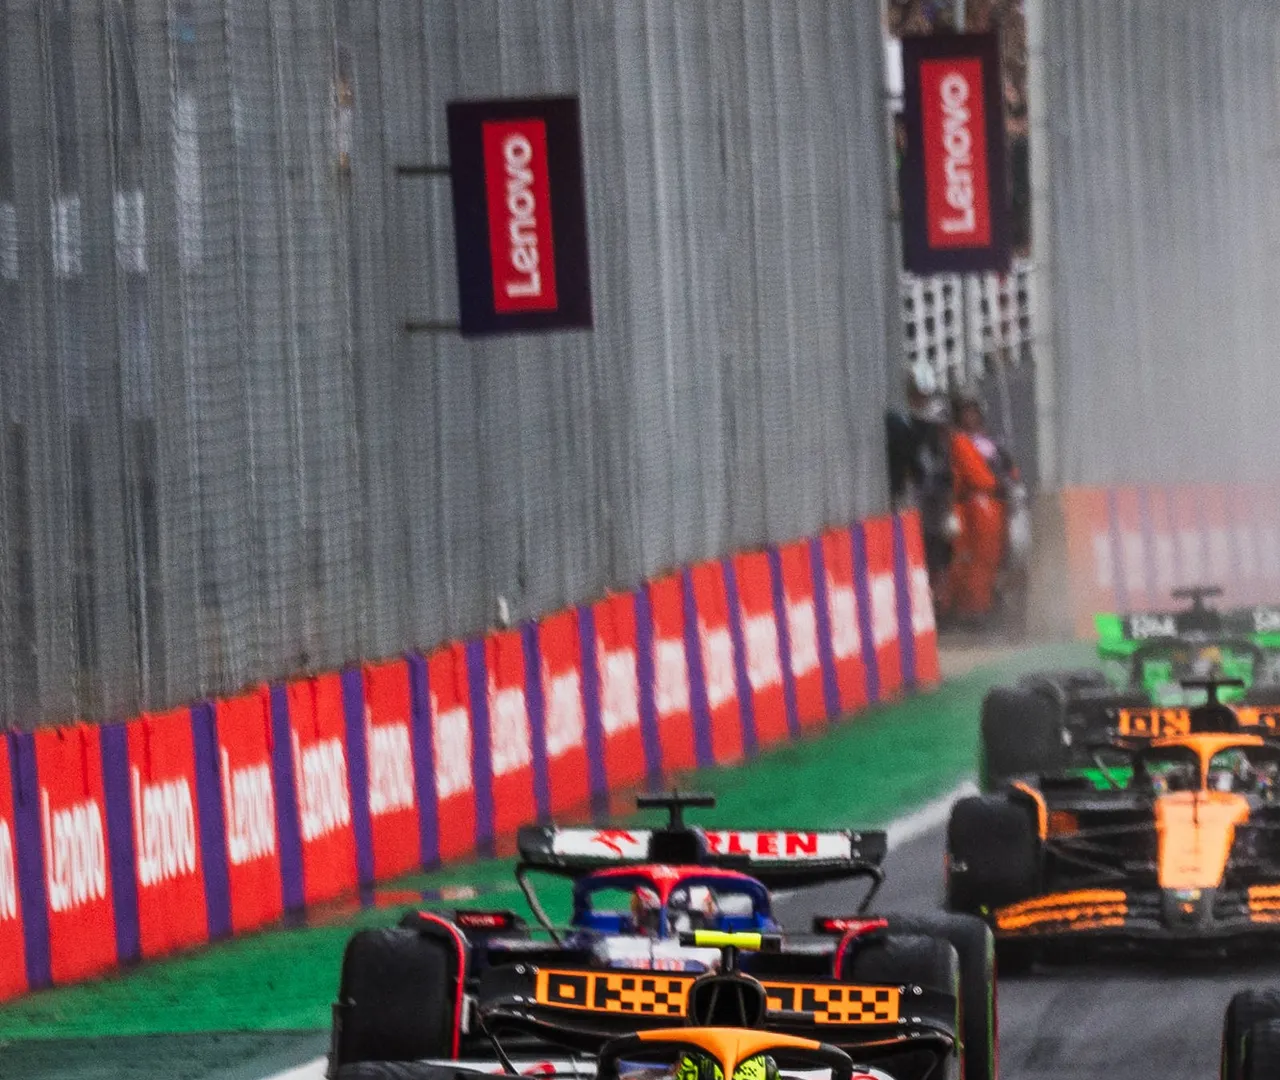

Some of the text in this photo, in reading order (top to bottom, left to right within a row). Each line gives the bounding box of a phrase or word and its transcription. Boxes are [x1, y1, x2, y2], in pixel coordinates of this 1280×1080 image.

[503, 134, 541, 298] Lenovo
[939, 72, 976, 234] Lenovo
[706, 830, 818, 857] RLEN
